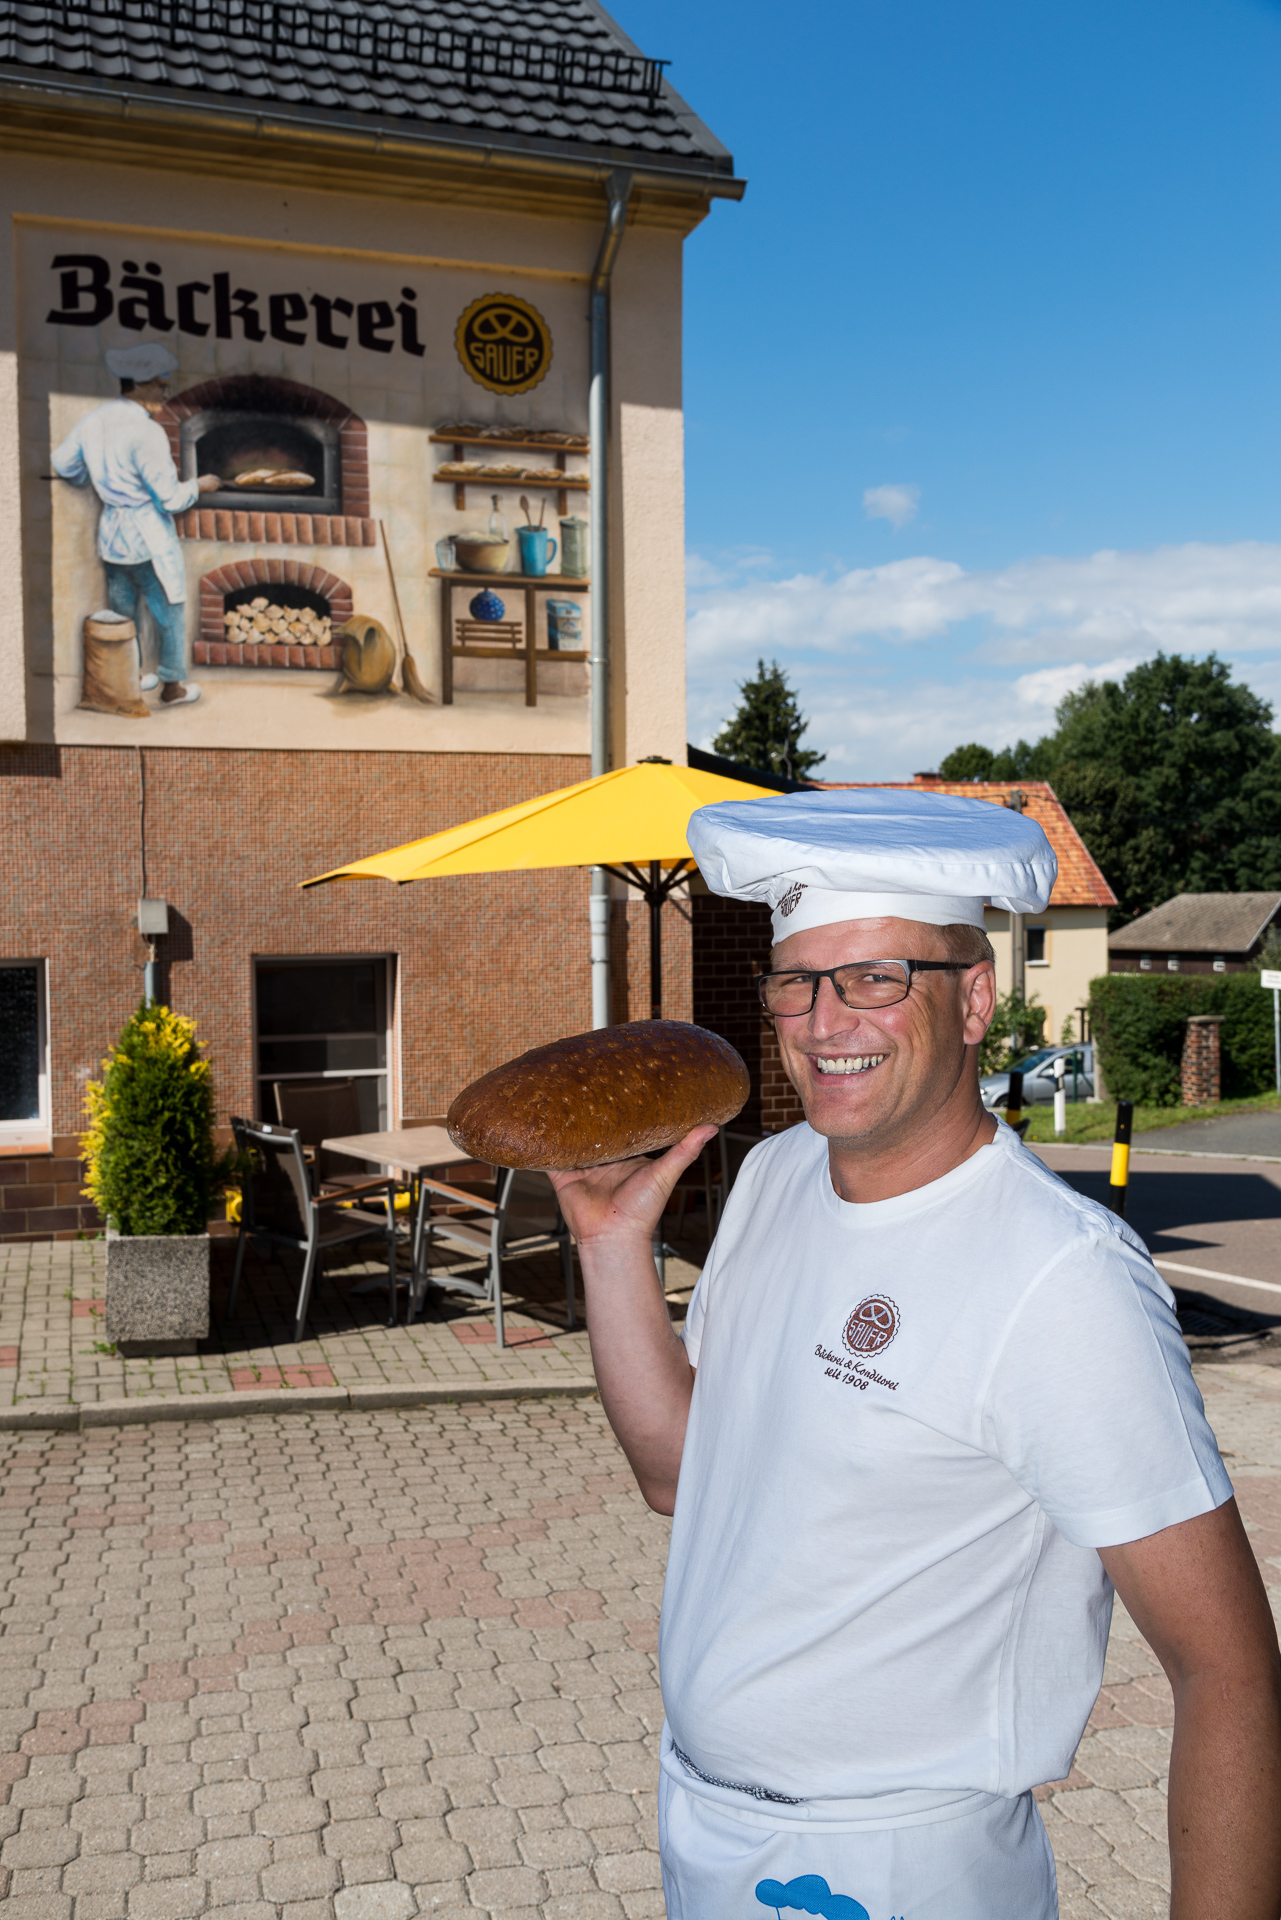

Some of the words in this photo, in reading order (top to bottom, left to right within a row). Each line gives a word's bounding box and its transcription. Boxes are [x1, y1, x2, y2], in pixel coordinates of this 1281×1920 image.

[46, 254, 426, 357] Bäckerei
[469, 342, 539, 381] SAUER
[849, 1319, 888, 1349] SAUER
[824, 1367, 842, 1380] seit
[841, 1373, 870, 1391] 1908
[843, 1359, 853, 1370] &
[851, 1361, 900, 1391] Konditorei
